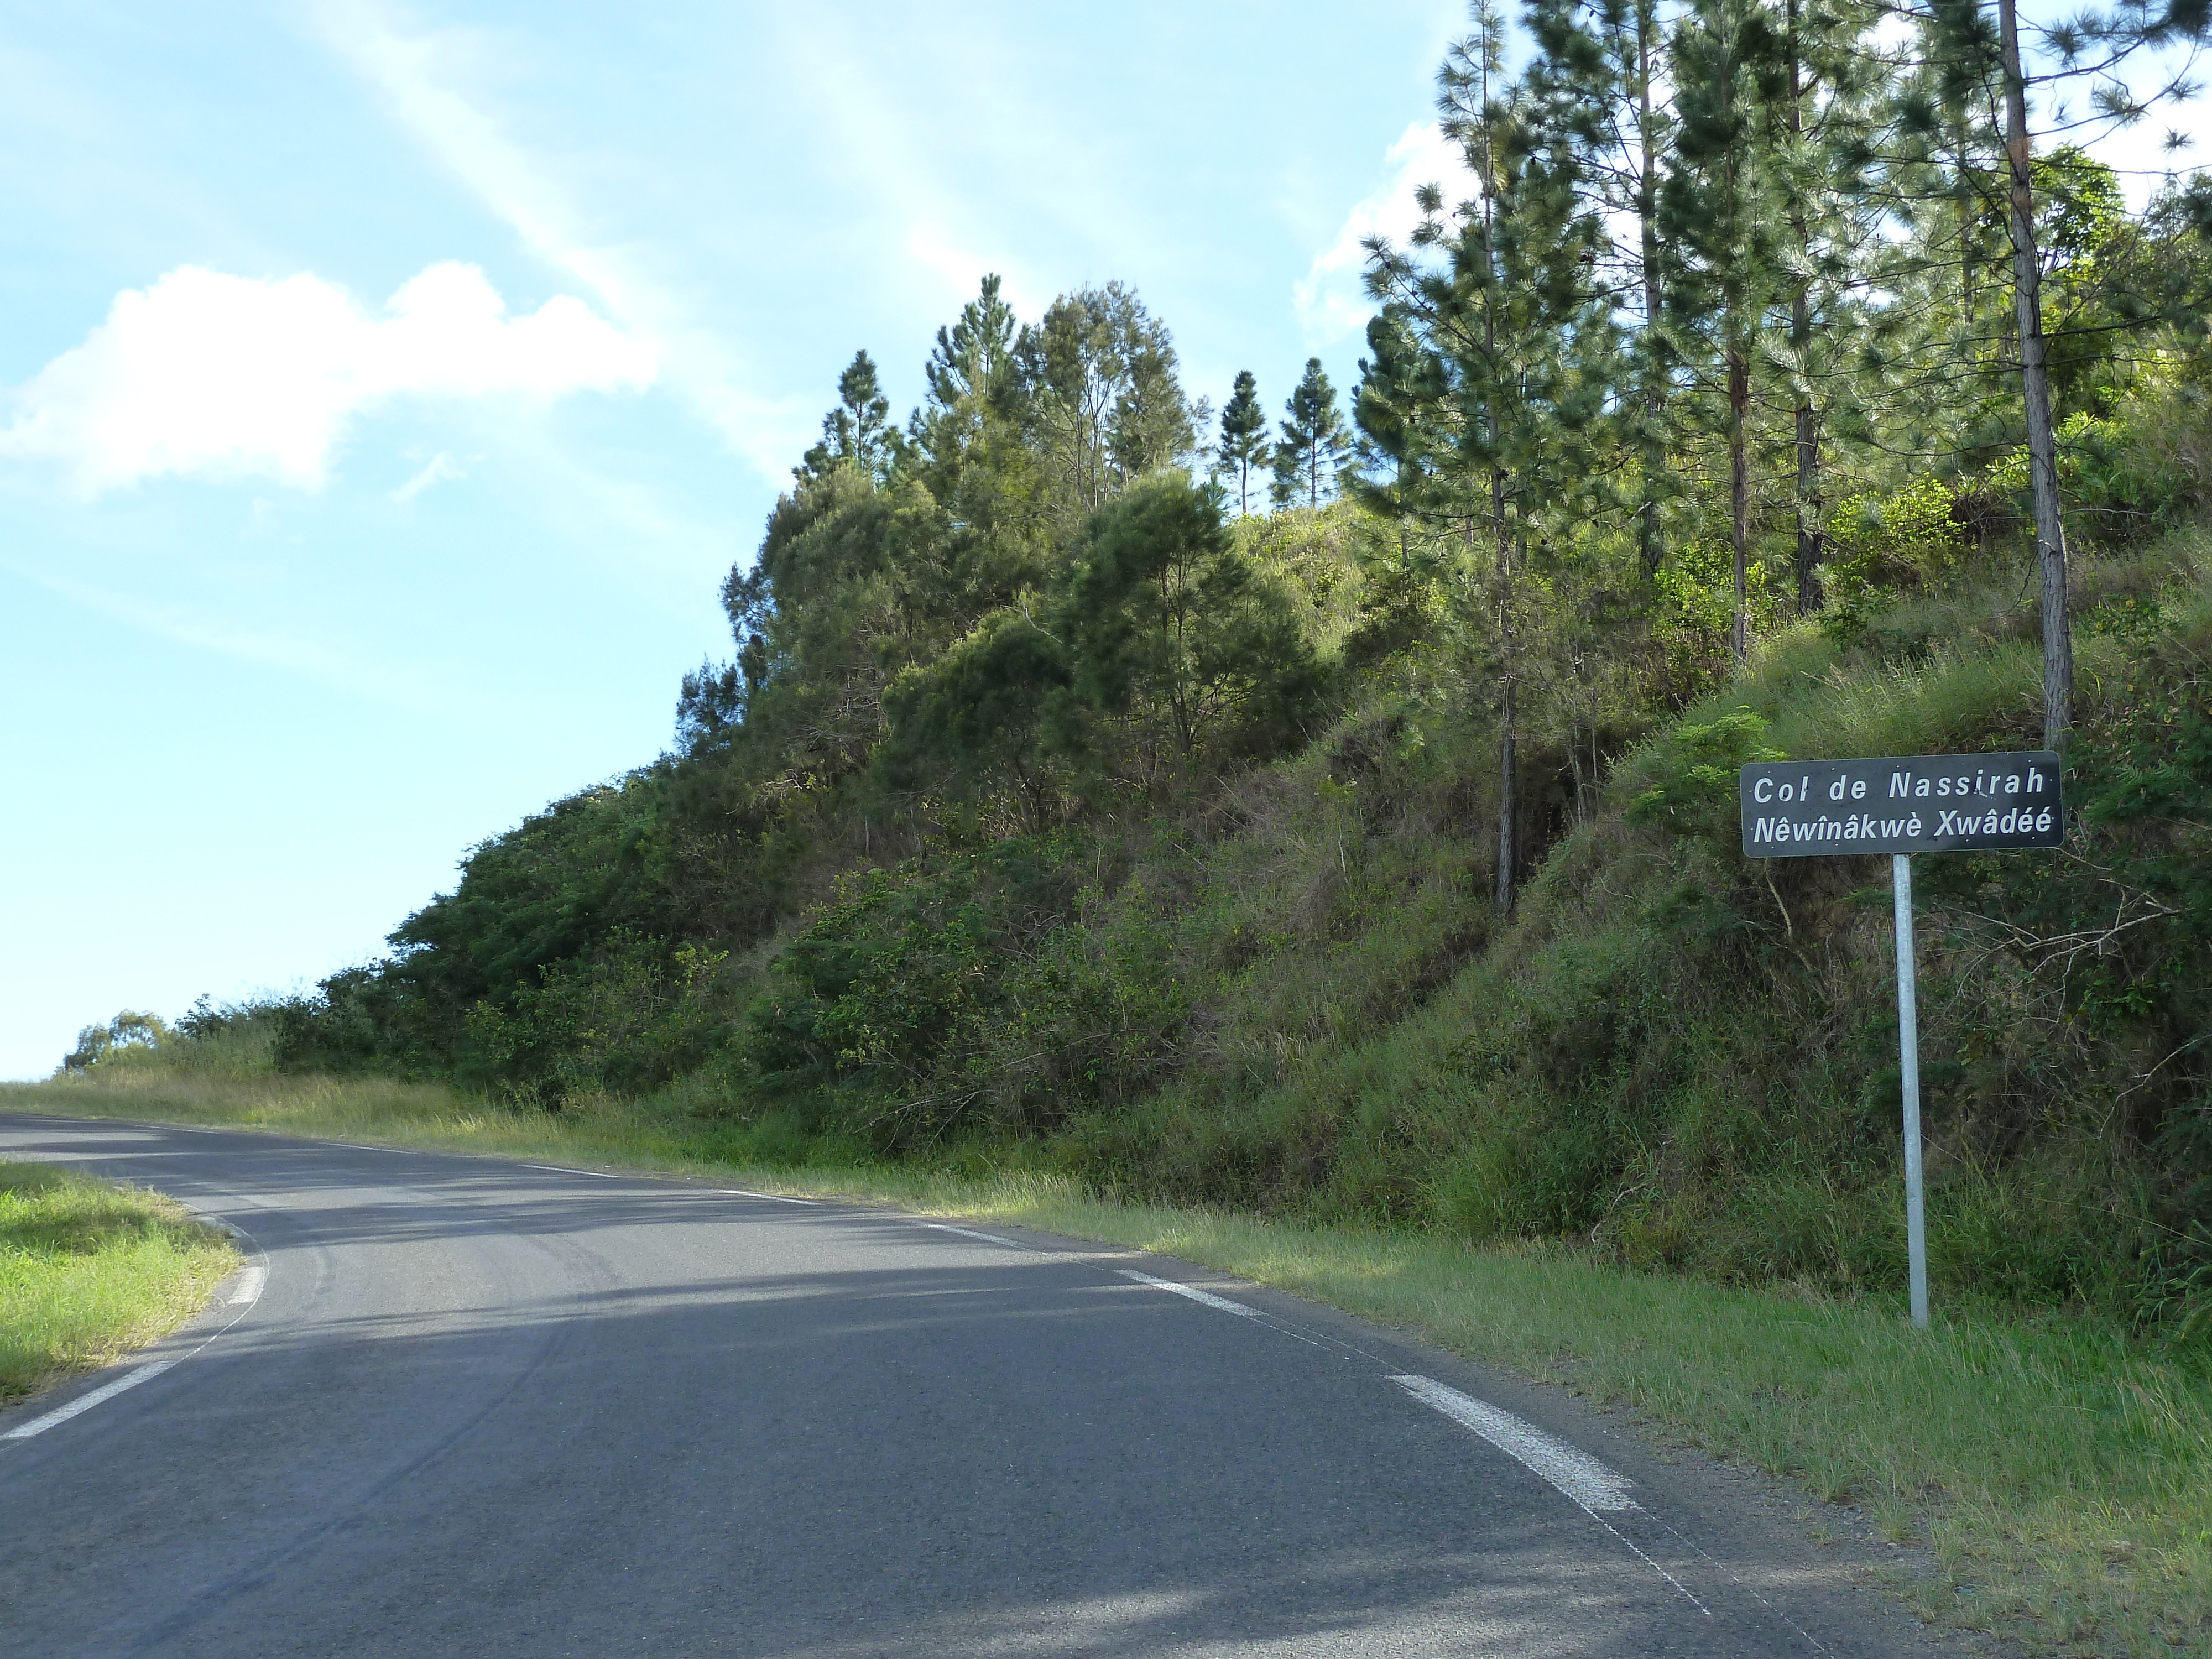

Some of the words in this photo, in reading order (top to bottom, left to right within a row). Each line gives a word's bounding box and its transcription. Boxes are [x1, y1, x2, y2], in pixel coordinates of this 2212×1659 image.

[1754, 776, 1808, 803] Col
[1829, 775, 1866, 800] de
[1888, 767, 2043, 799] Nassirah
[1754, 812, 1922, 843] Nêwînâkwè
[1934, 806, 2052, 836] Xwâdéé
